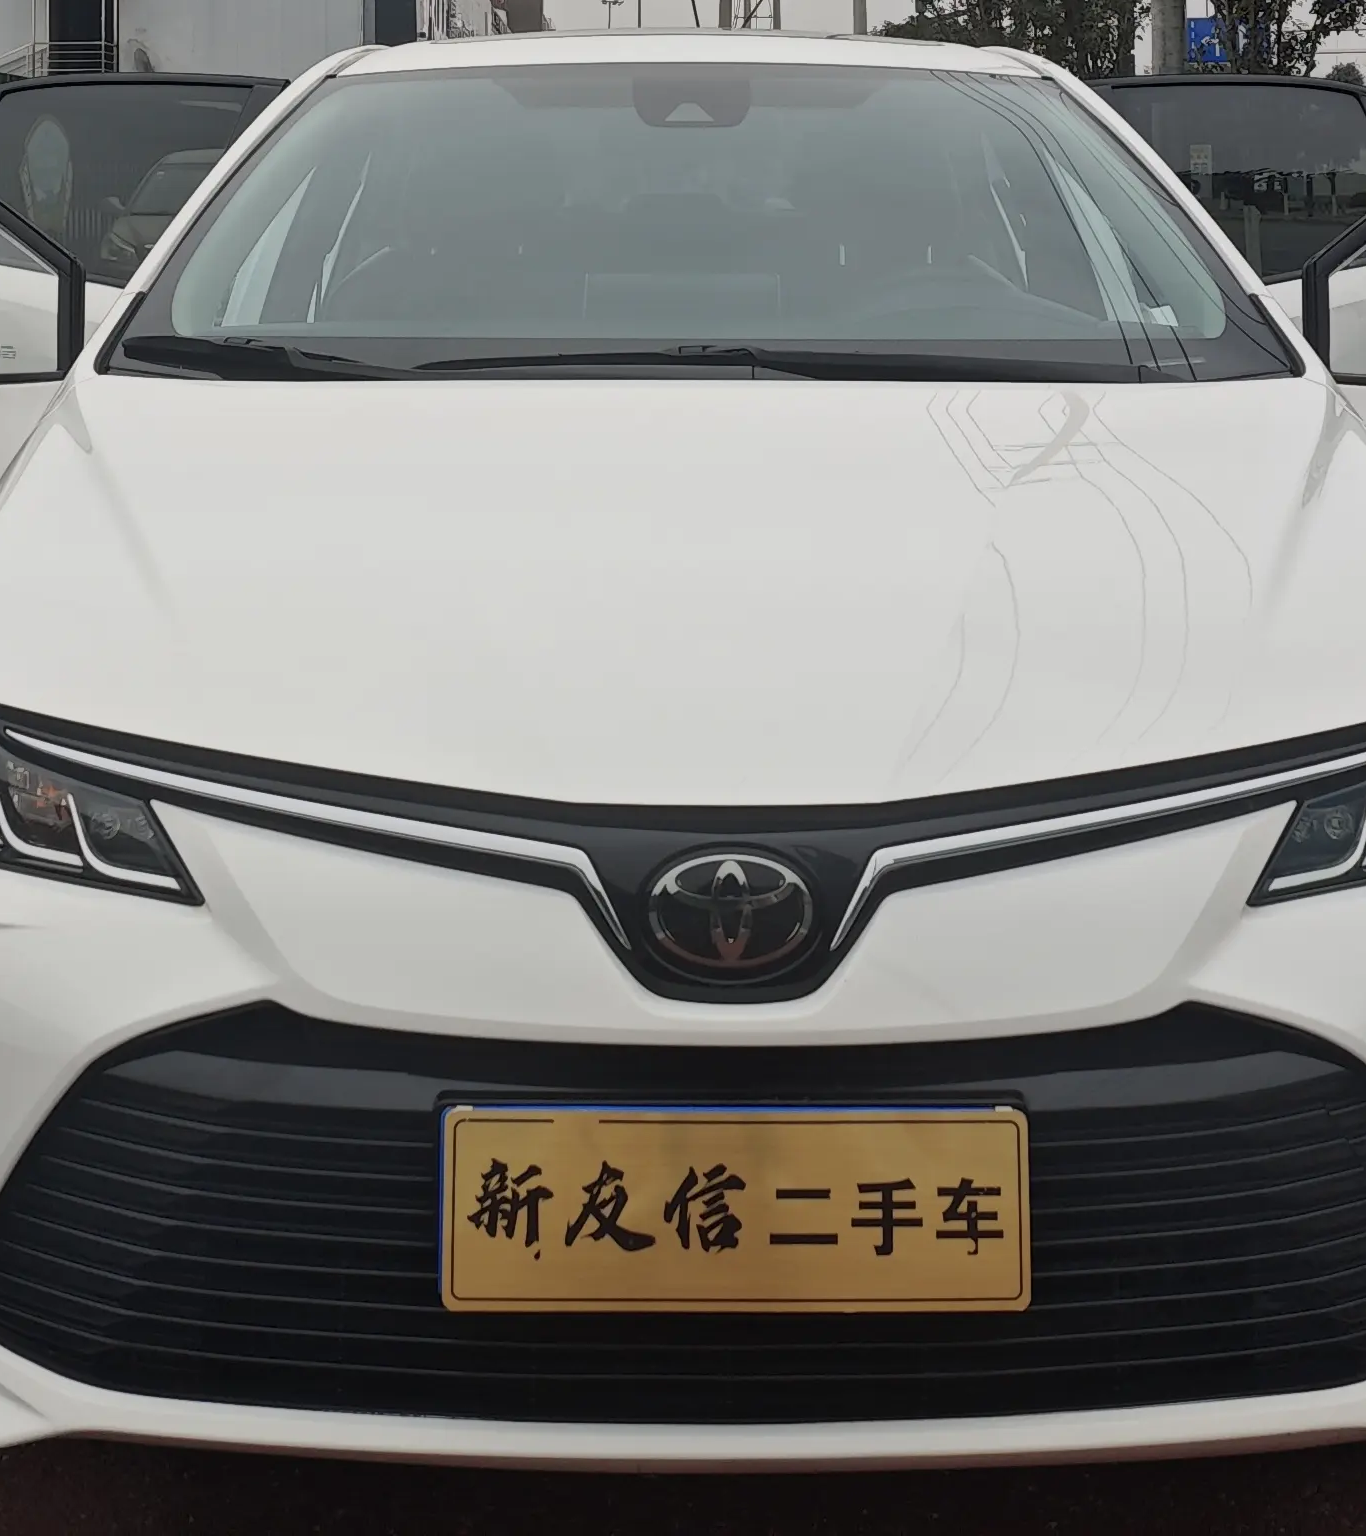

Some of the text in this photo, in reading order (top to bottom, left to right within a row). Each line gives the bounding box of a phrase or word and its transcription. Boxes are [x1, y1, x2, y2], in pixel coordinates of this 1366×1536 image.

[467, 1158, 1005, 1260] 新友信二手车
